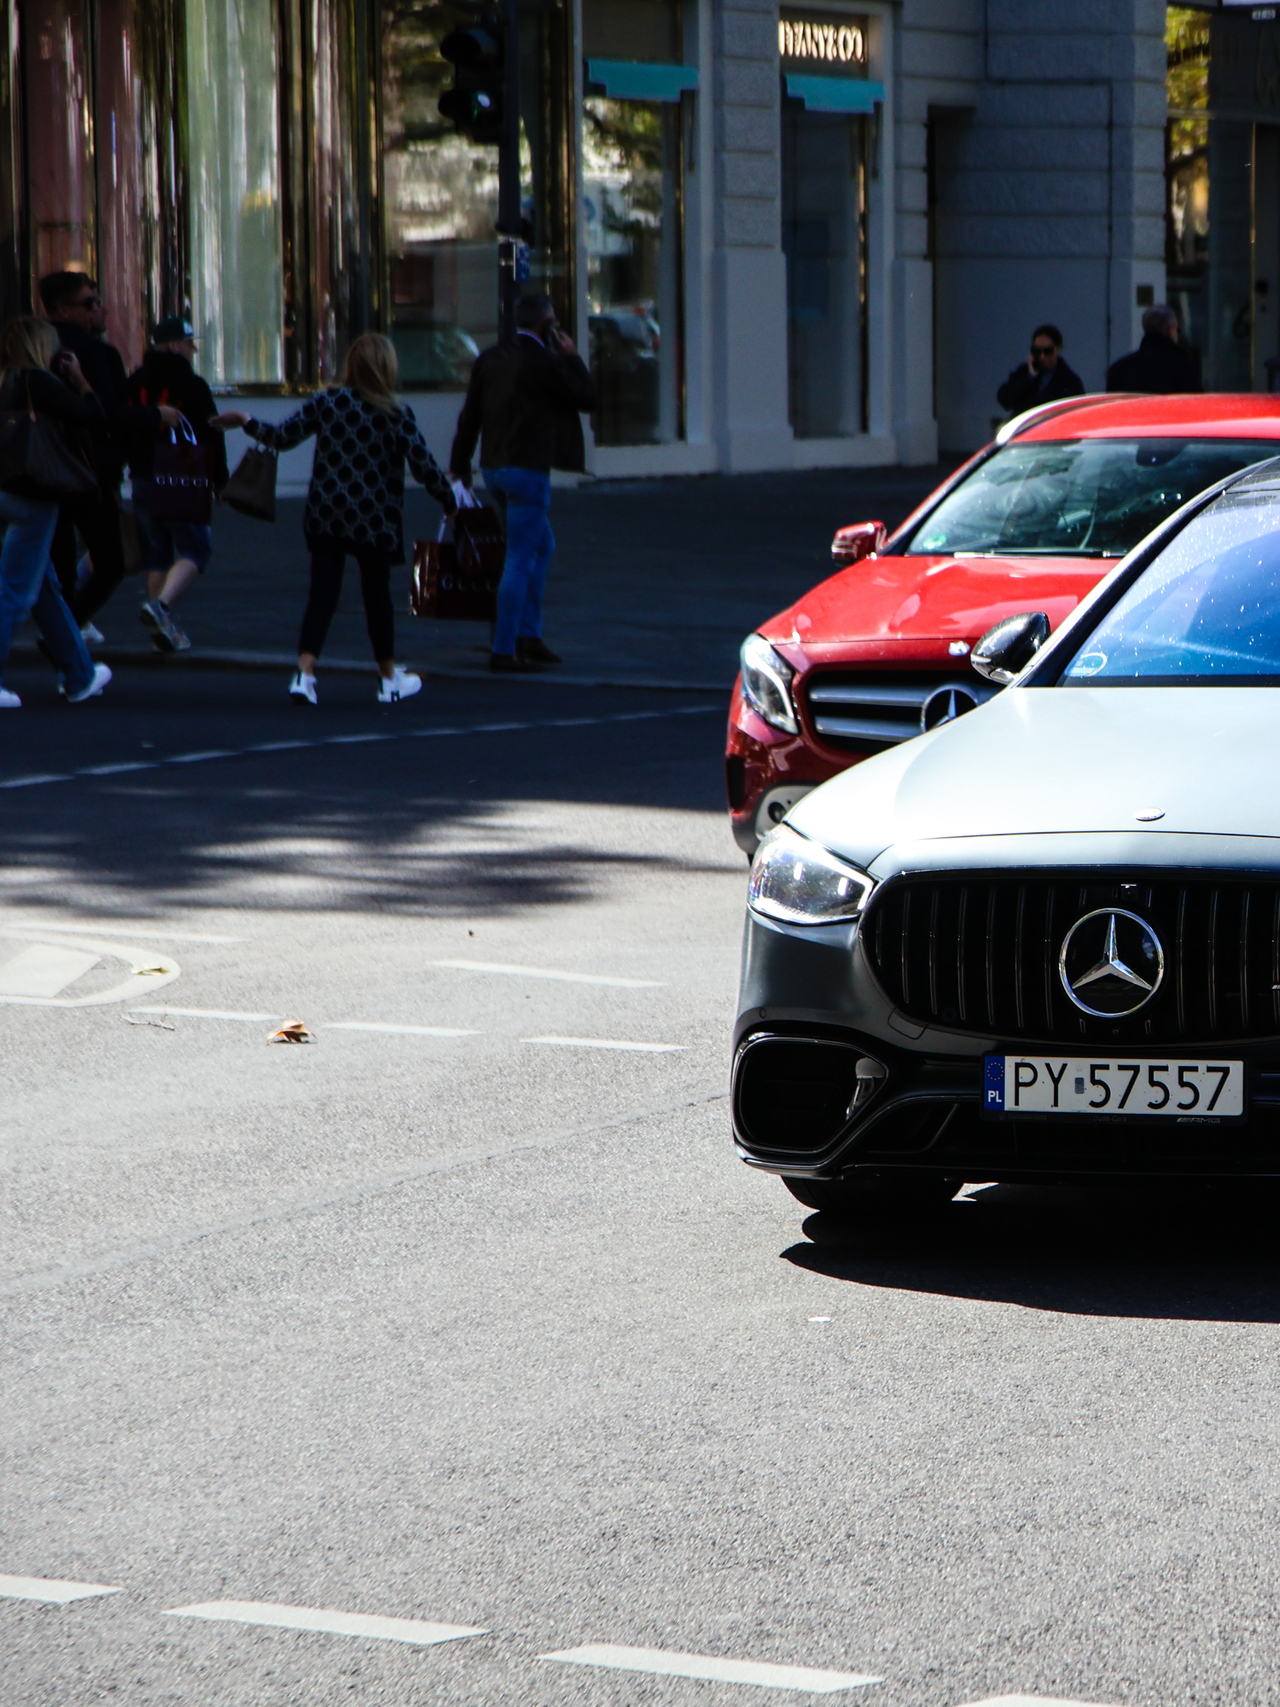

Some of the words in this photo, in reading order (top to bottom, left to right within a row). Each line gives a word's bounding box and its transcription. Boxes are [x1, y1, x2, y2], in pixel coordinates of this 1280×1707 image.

[155, 475, 209, 489] GUCCI
[1014, 1061, 1069, 1108] PY
[1088, 1063, 1231, 1111] 57557
[987, 1089, 1003, 1103] PL
[1189, 1116, 1221, 1124] AMG
